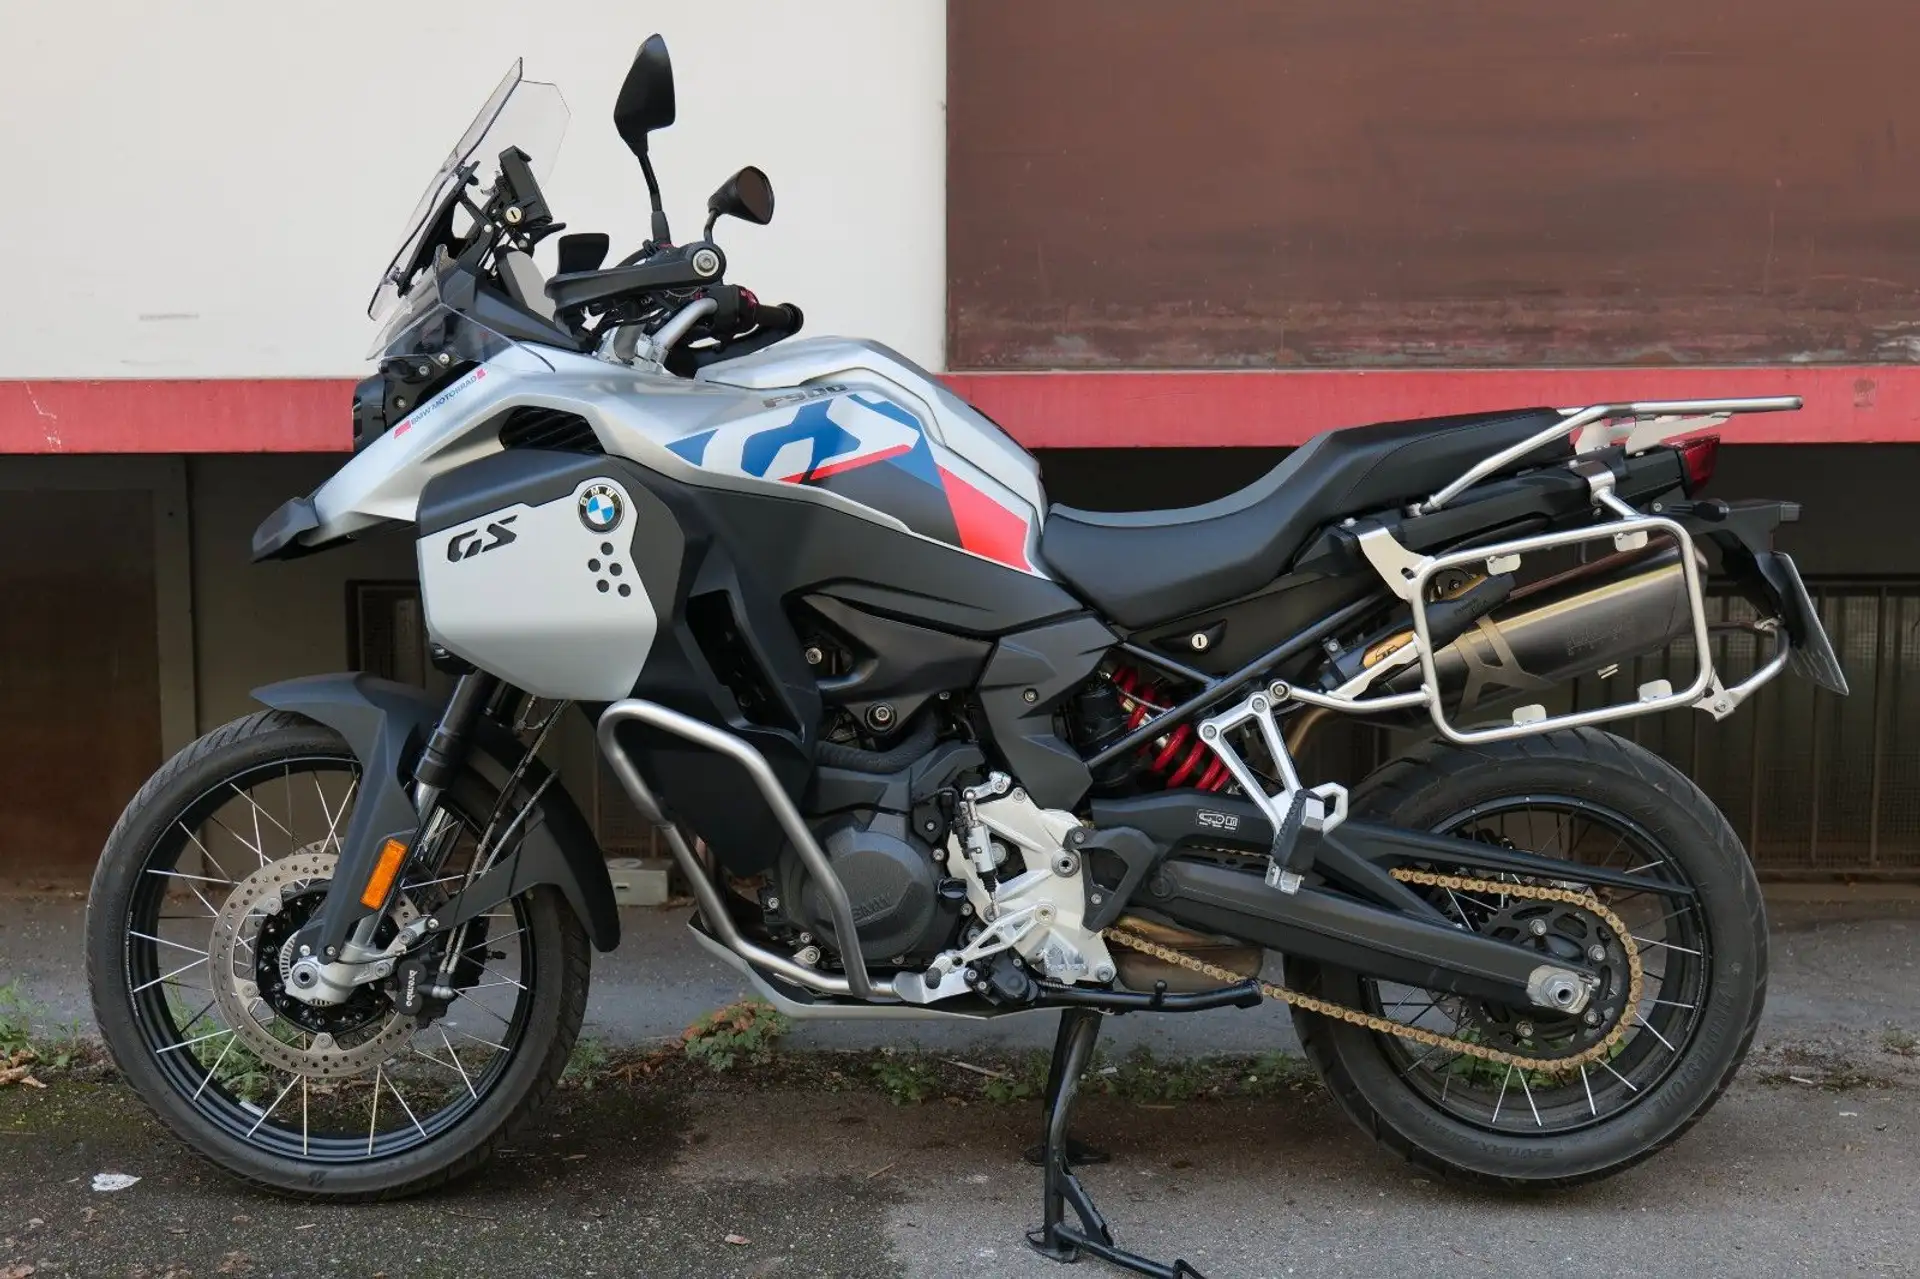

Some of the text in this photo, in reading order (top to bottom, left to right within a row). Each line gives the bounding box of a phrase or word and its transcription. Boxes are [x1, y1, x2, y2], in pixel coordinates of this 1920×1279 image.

[580, 485, 616, 507] BMW
[447, 514, 518, 563] GS
[405, 969, 418, 1007] brembo
